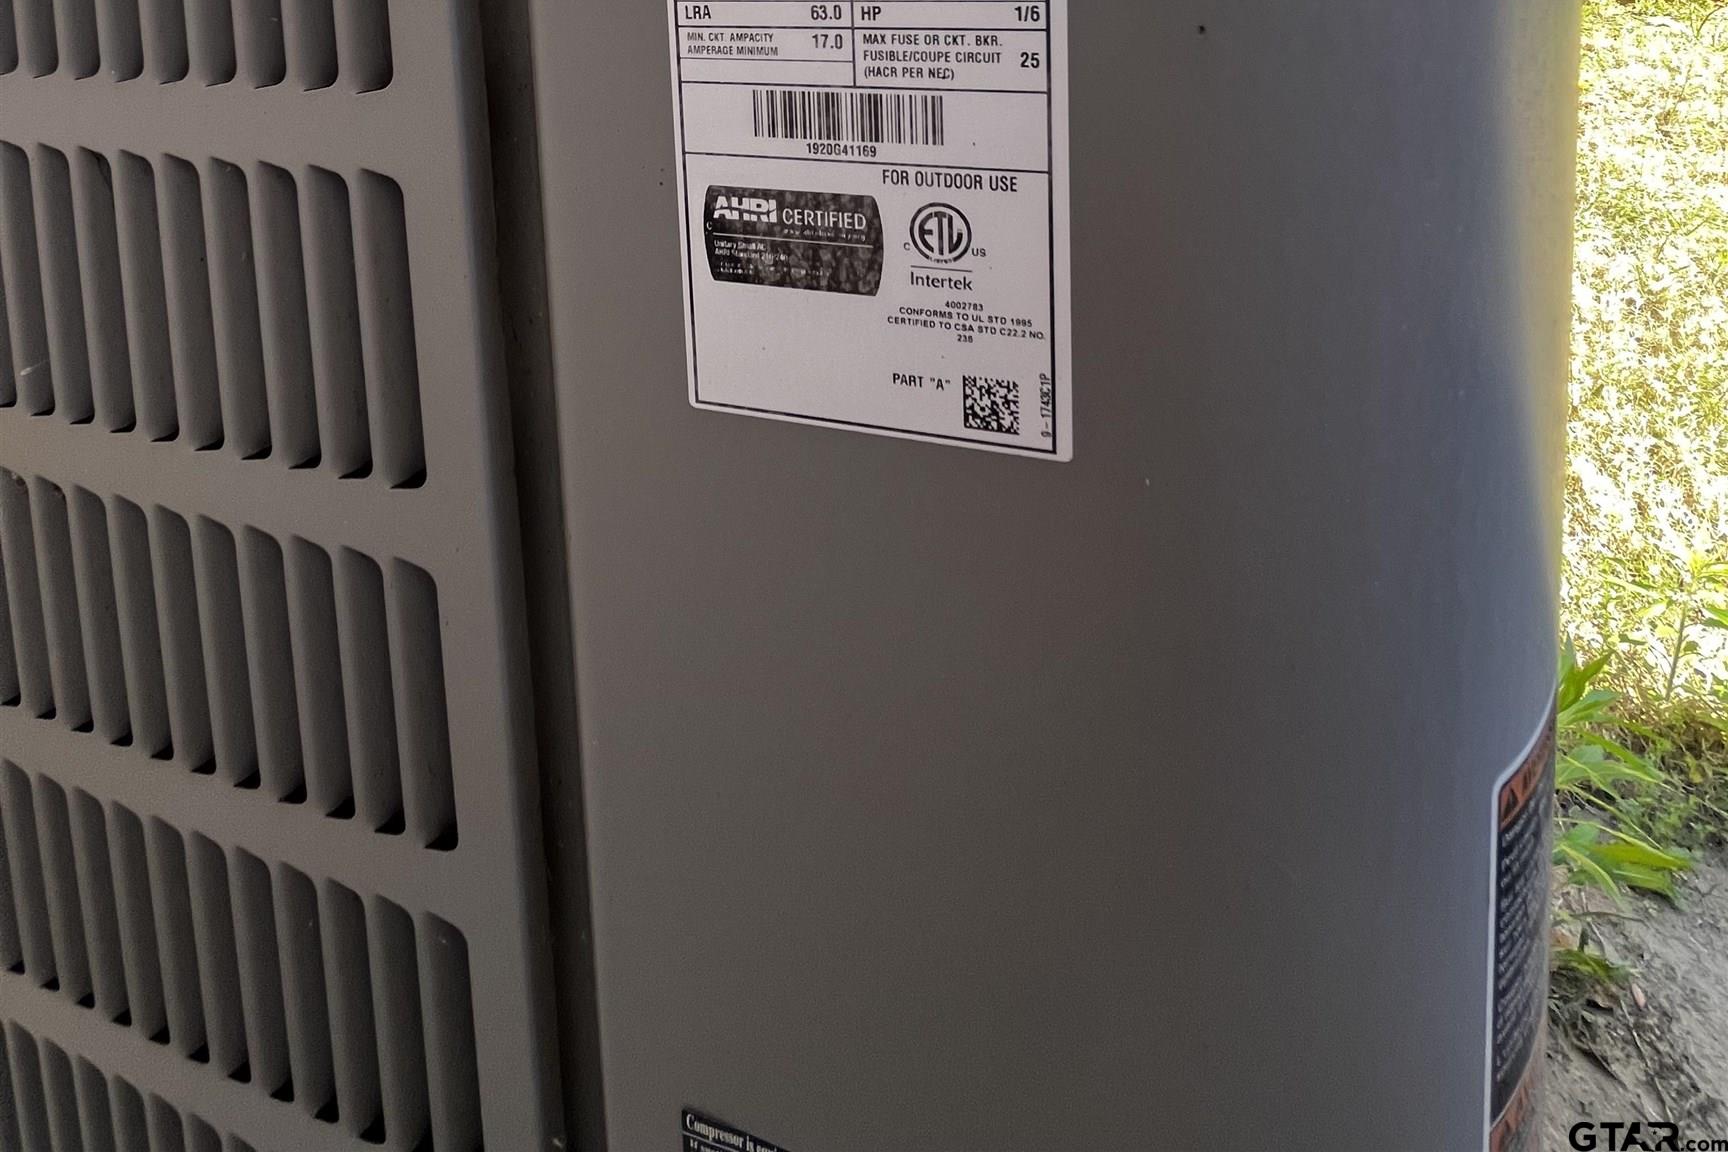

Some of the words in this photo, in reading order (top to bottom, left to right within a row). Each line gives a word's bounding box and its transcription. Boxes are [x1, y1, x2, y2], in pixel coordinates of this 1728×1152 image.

[685, 5, 712, 20] LRA
[811, 5, 842, 21] 63.0
[861, 6, 881, 21] HP
[1014, 6, 1040, 22] 1/6
[687, 32, 705, 41] MIN.
[730, 33, 773, 42] AMPACITY
[812, 34, 843, 49] 17.0
[863, 34, 886, 44] MAX
[891, 34, 919, 45] FUSE
[924, 35, 939, 45] OR
[944, 35, 971, 46] CKT.
[976, 35, 1003, 46] BKR.
[687, 46, 733, 55] AMPERAGE
[736, 46, 778, 56] MINIMUM
[864, 50, 950, 63] FUSIBLE/COUPE
[955, 52, 1001, 63] CIRCUIT
[1020, 52, 1040, 68] 25
[864, 67, 897, 78] (HACR
[902, 68, 923, 78] PER
[928, 68, 954, 80] NEC)
[806, 143, 877, 158] 1920G41169
[883, 170, 909, 185] FOR
[915, 171, 983, 189] OUTDOOR
[989, 176, 1017, 192] USE
[783, 208, 866, 229] CERTIFIED
[919, 211, 963, 256] ETL
[972, 248, 986, 257] US
[911, 272, 973, 291] Intertek
[888, 316, 935, 328] CERTIFIED
[899, 307, 953, 319] CONFORMS
[957, 313, 969, 321] TO
[972, 315, 984, 323] UL
[893, 373, 924, 388] PART
